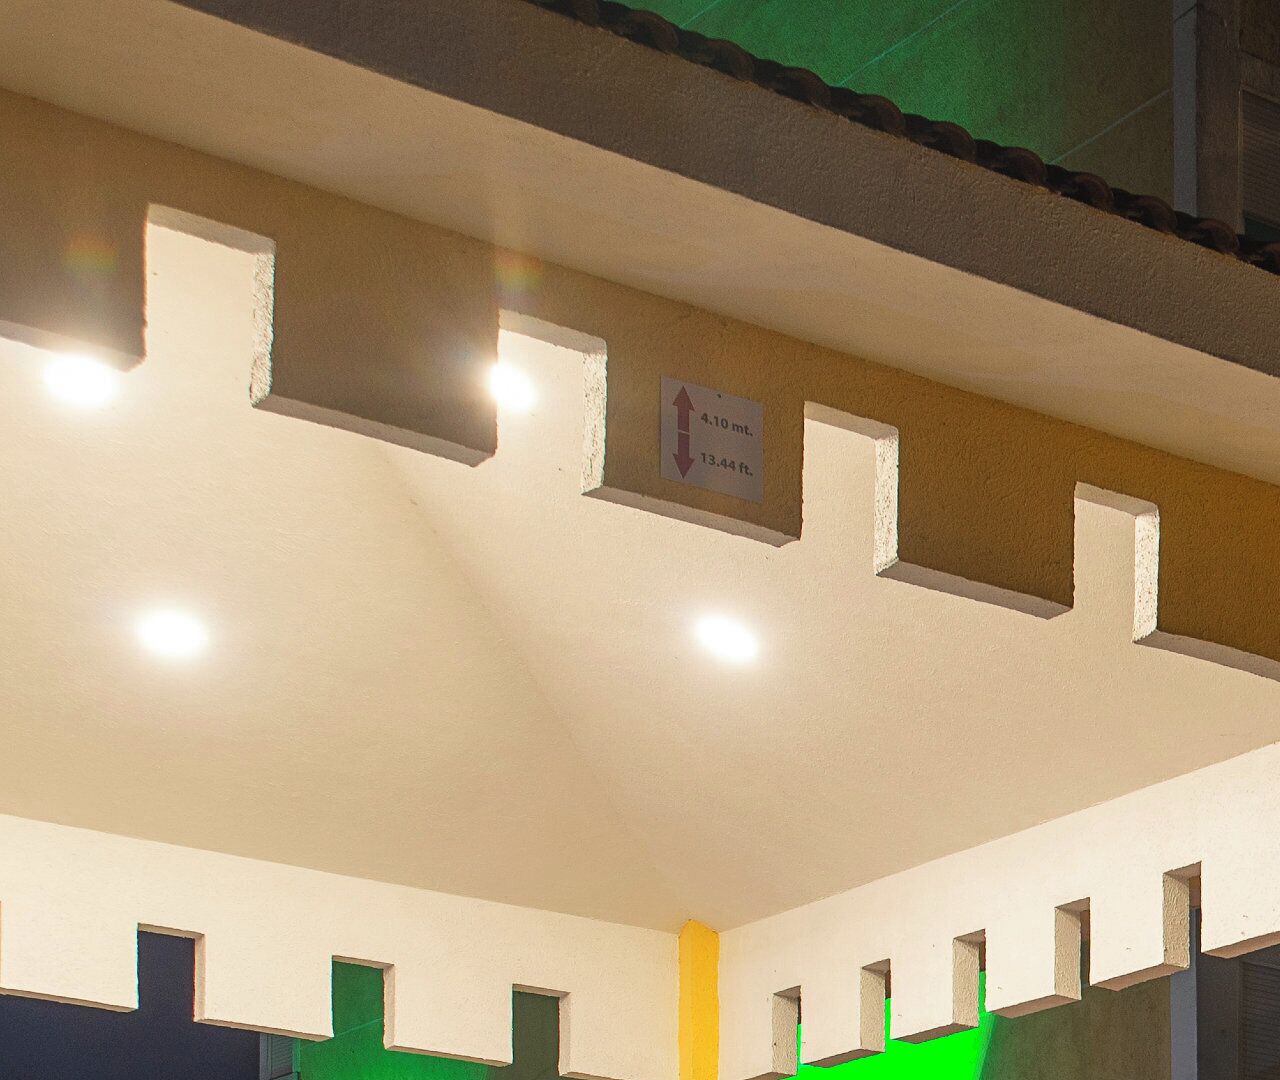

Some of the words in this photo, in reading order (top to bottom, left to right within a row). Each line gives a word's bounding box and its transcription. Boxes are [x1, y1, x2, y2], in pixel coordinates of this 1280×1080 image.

[700, 412, 729, 430] 4.10
[732, 421, 754, 437] mt.
[700, 452, 736, 473] 13.44
[739, 461, 754, 477] ft.
